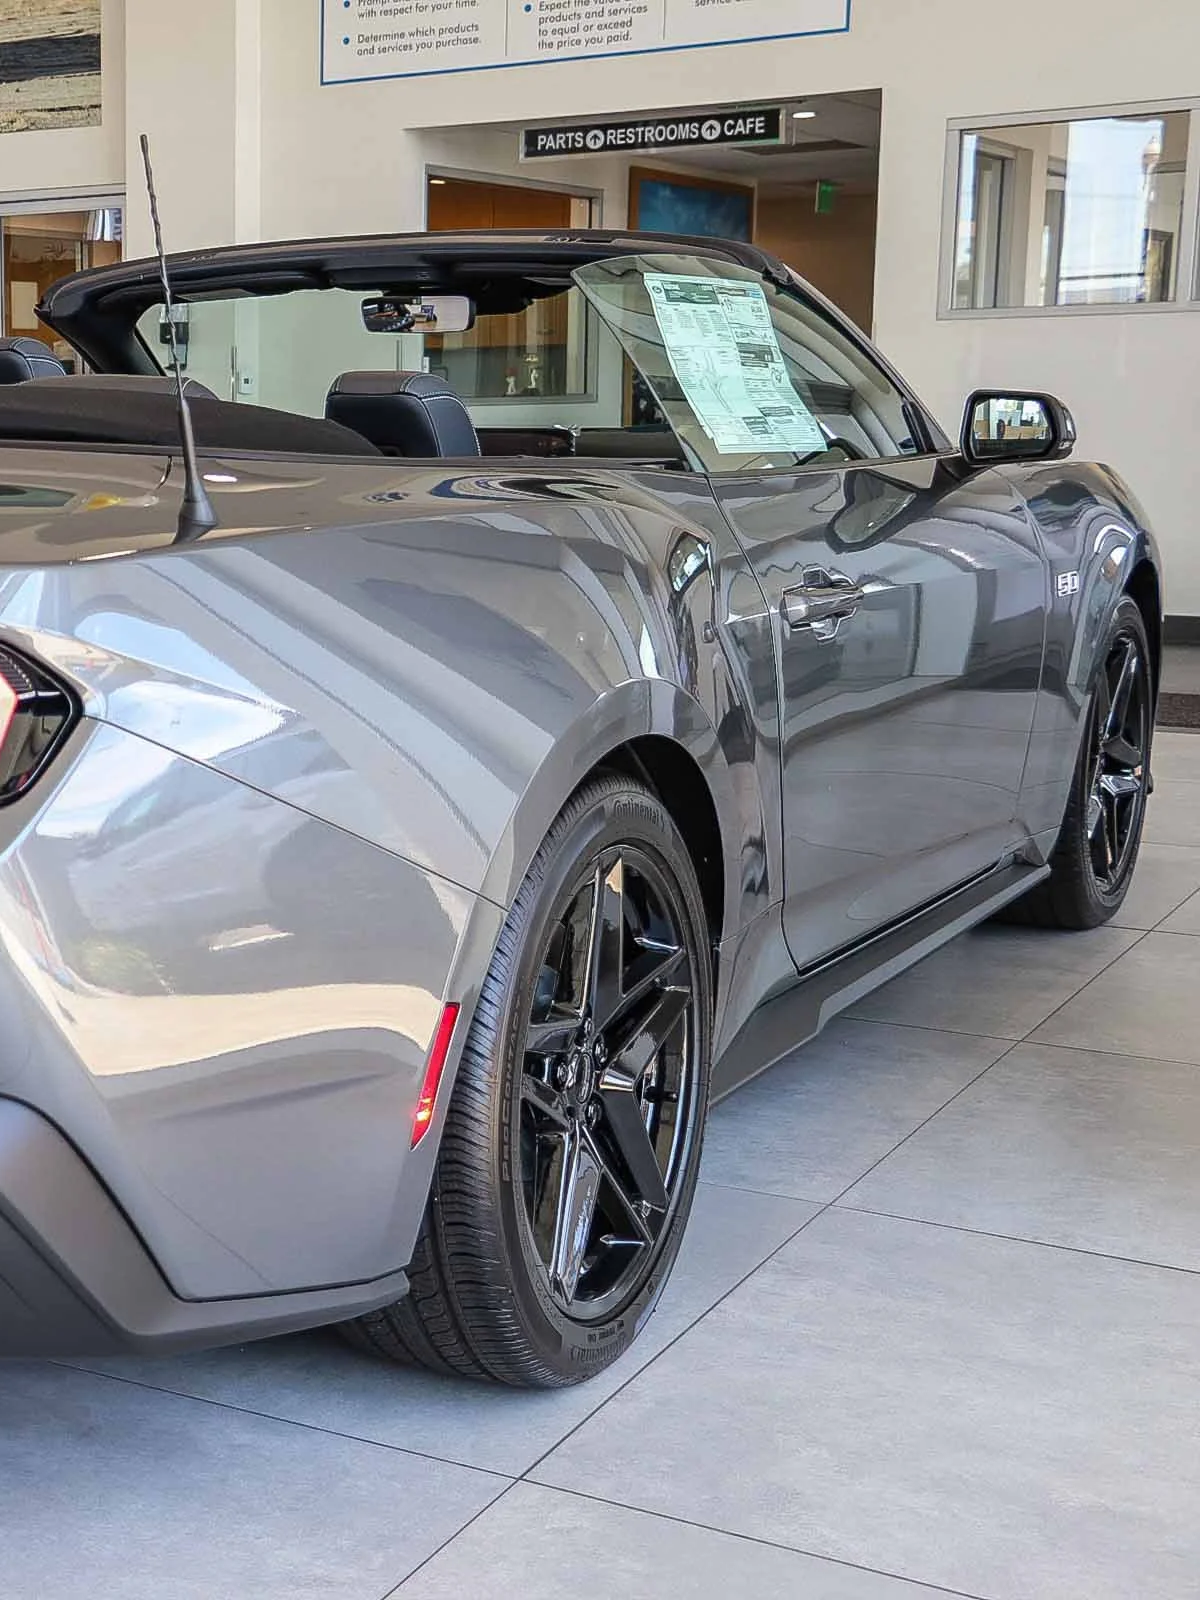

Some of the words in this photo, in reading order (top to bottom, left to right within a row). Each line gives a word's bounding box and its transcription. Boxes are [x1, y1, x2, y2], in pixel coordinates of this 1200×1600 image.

[358, 9, 377, 20] with
[379, 6, 413, 18] respect
[415, 2, 428, 13] for
[431, 2, 452, 13] your
[538, 0, 571, 12] Expect
[538, 11, 581, 25] products
[584, 8, 605, 19] and
[607, 5, 648, 16] services
[357, 31, 406, 44] Determine
[408, 25, 436, 39] which
[438, 22, 480, 36] products
[538, 28, 549, 37] to
[551, 23, 580, 37] equal
[582, 24, 593, 33] or
[596, 17, 633, 31] exceed
[356, 46, 375, 57] and
[377, 43, 414, 54] services
[415, 40, 433, 52] you
[435, 36, 482, 49] purchase.
[537, 39, 554, 50] the
[556, 37, 581, 50] price
[584, 36, 604, 47] you
[606, 31, 632, 45] paid.
[537, 131, 584, 151] PARTS
[606, 122, 700, 145] RESTROOMS
[723, 116, 766, 137] CAFE
